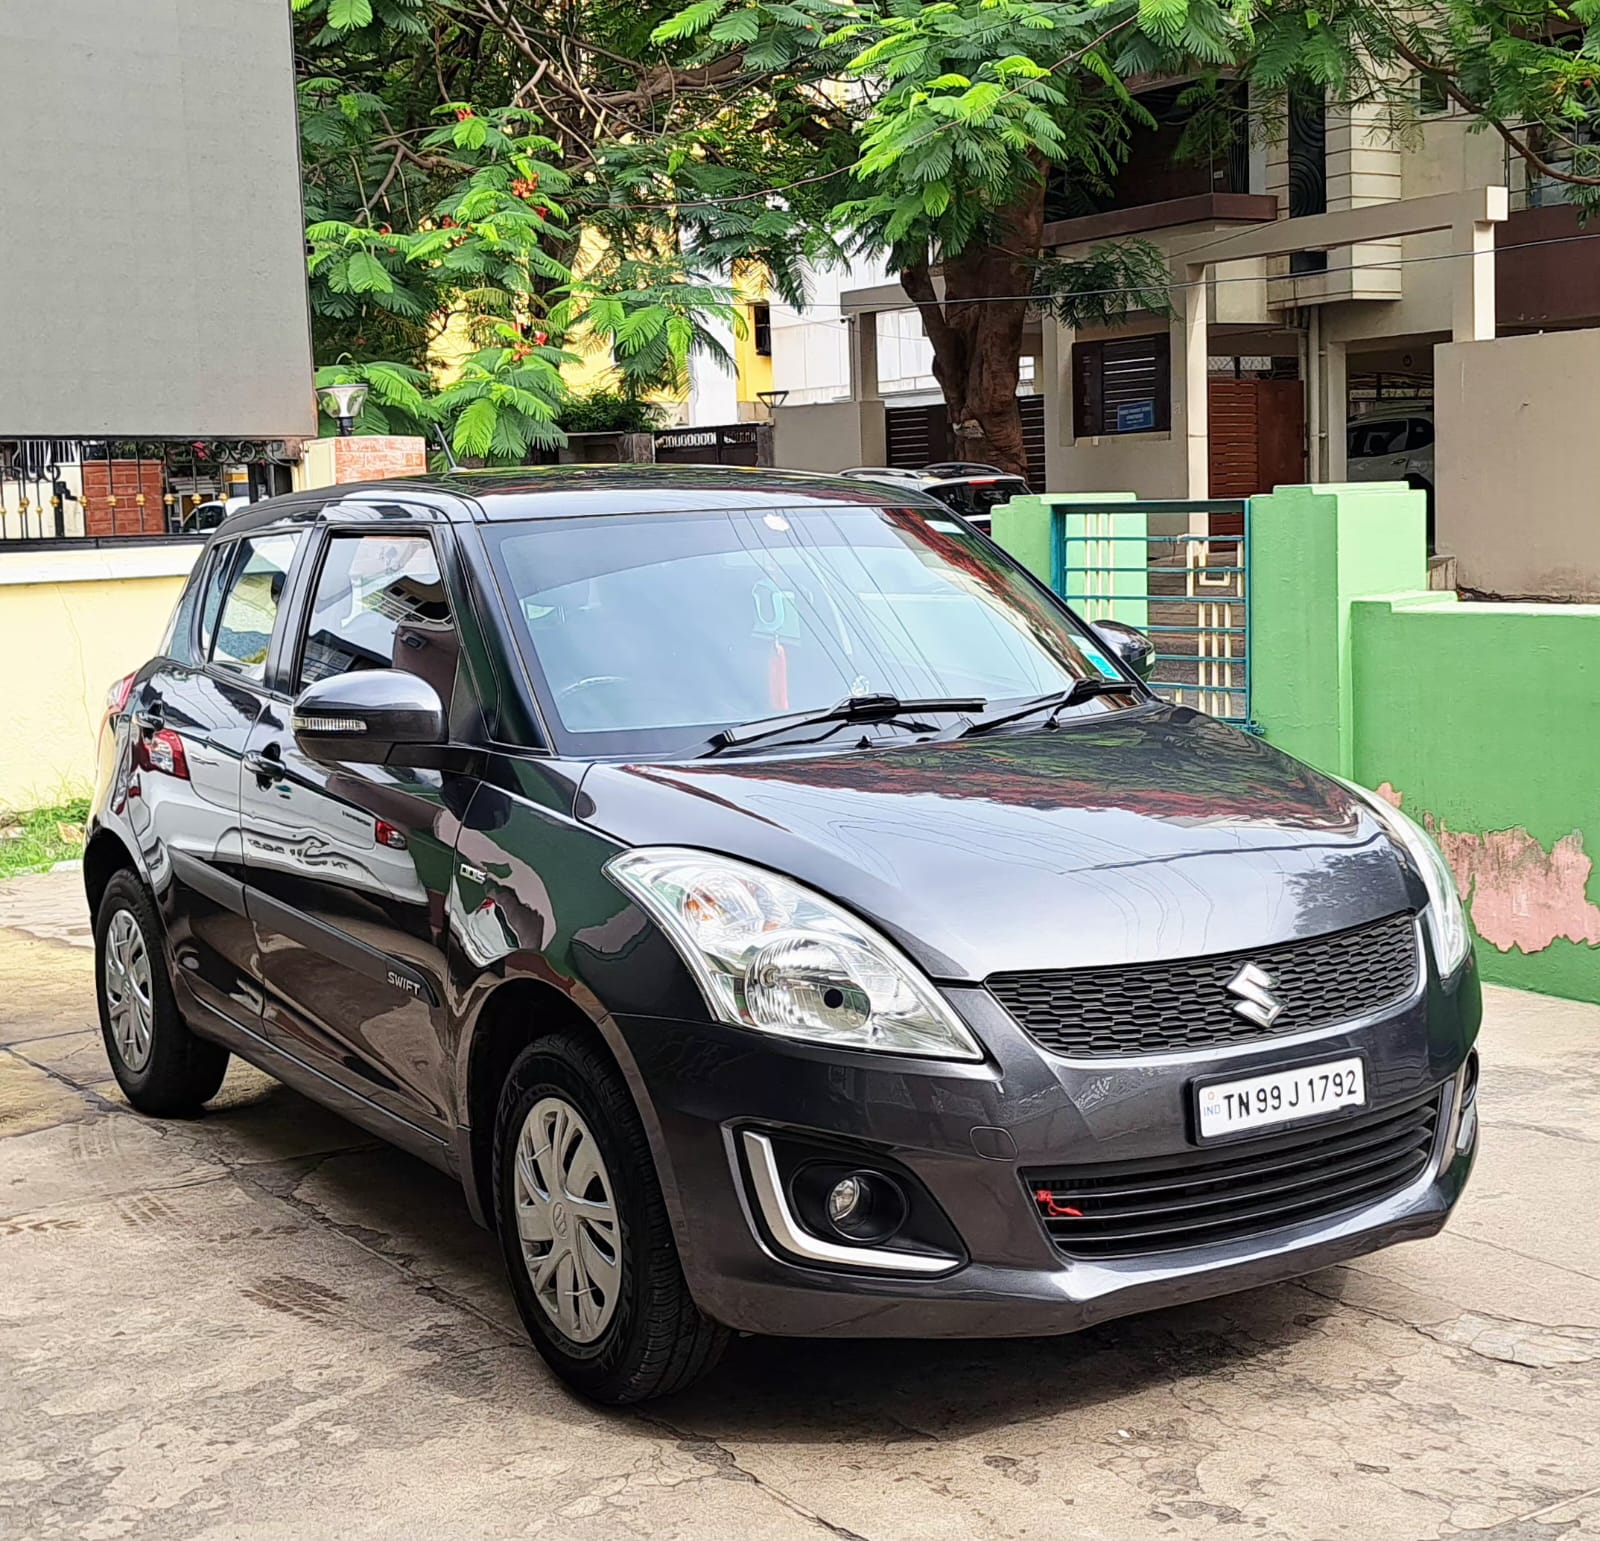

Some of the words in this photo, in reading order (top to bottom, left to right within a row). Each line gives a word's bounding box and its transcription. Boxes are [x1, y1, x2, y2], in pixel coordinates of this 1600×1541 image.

[387, 971, 421, 996] SWIFT
[1223, 1090, 1251, 1121] TN
[1256, 1085, 1282, 1114] 99
[1288, 1081, 1300, 1108] J
[1308, 1069, 1358, 1104] 1792
[1203, 1103, 1221, 1117] IND
